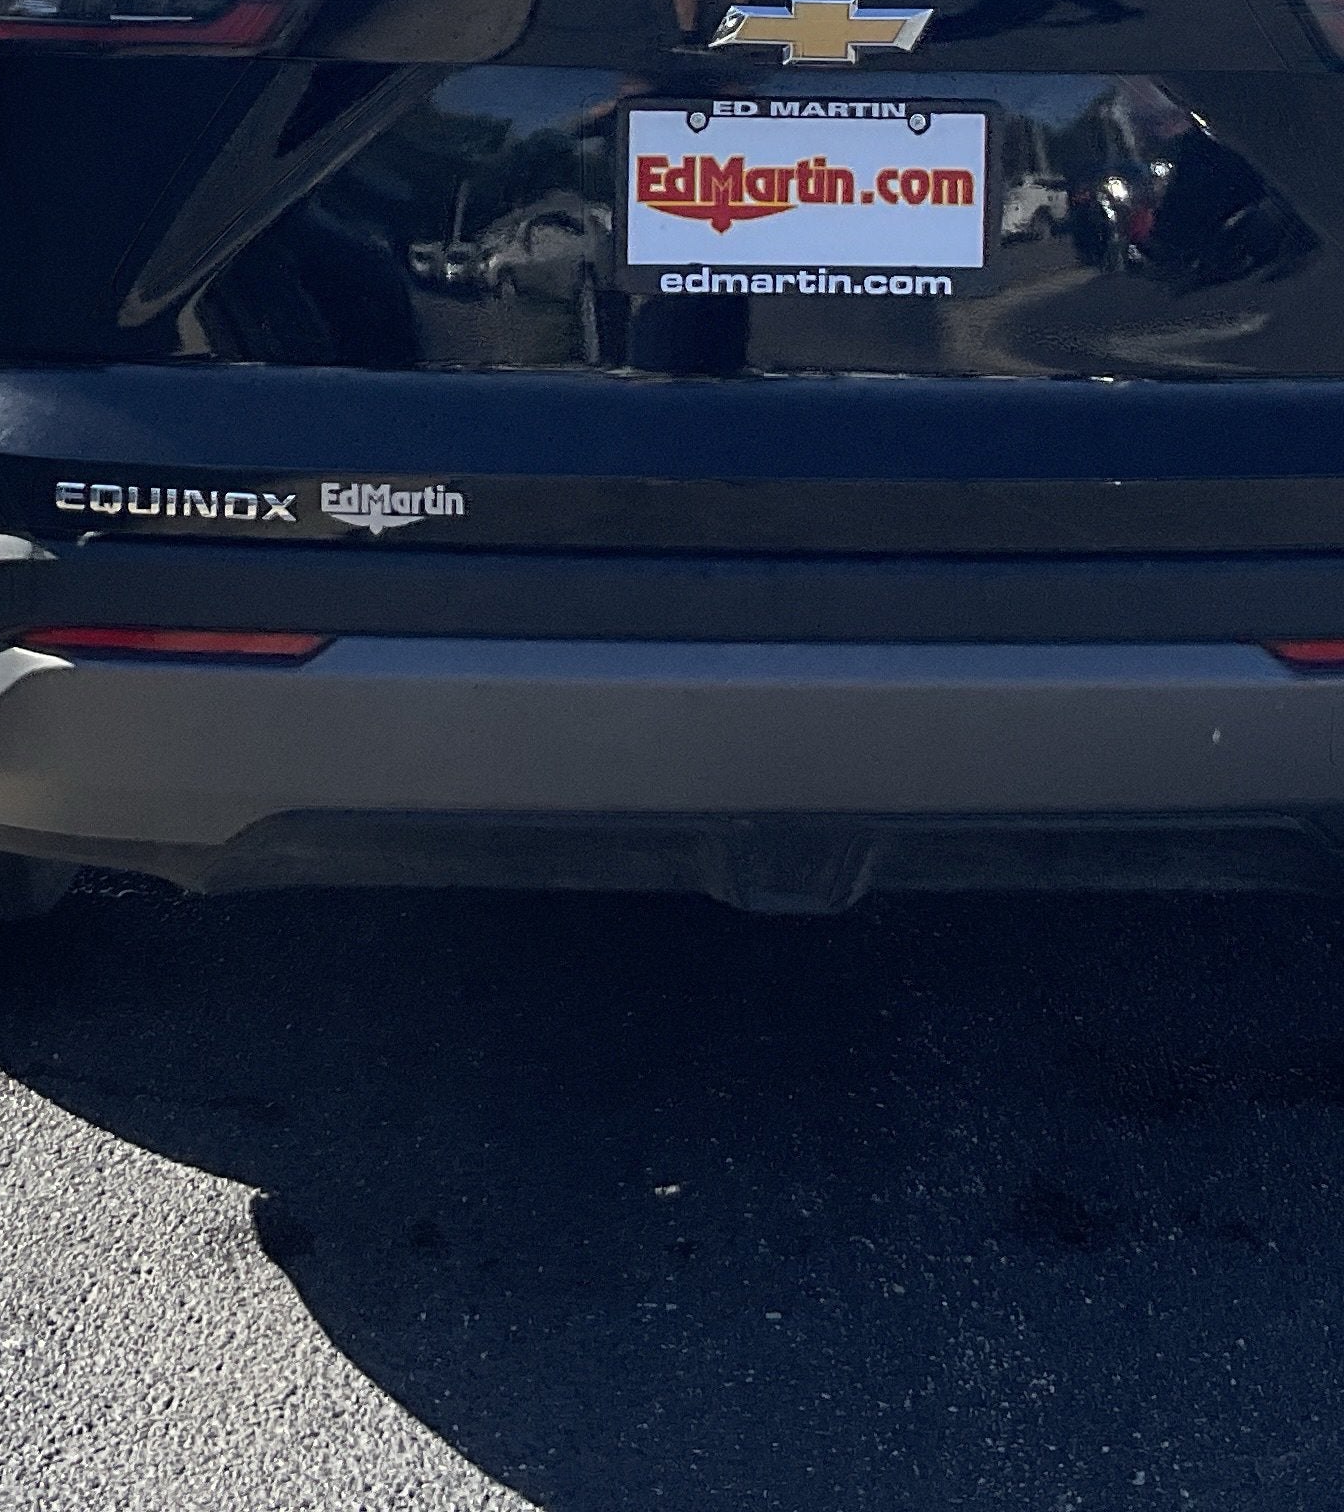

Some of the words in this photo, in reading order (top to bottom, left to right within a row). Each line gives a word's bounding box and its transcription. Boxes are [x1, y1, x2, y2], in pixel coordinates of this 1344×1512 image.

[712, 101, 759, 117] ED
[770, 101, 907, 119] MARTIN
[636, 154, 976, 207] EdMartin.com
[660, 267, 954, 296] edmartin.com
[55, 481, 298, 523] EQUINOX
[320, 482, 465, 518] EdMartin
